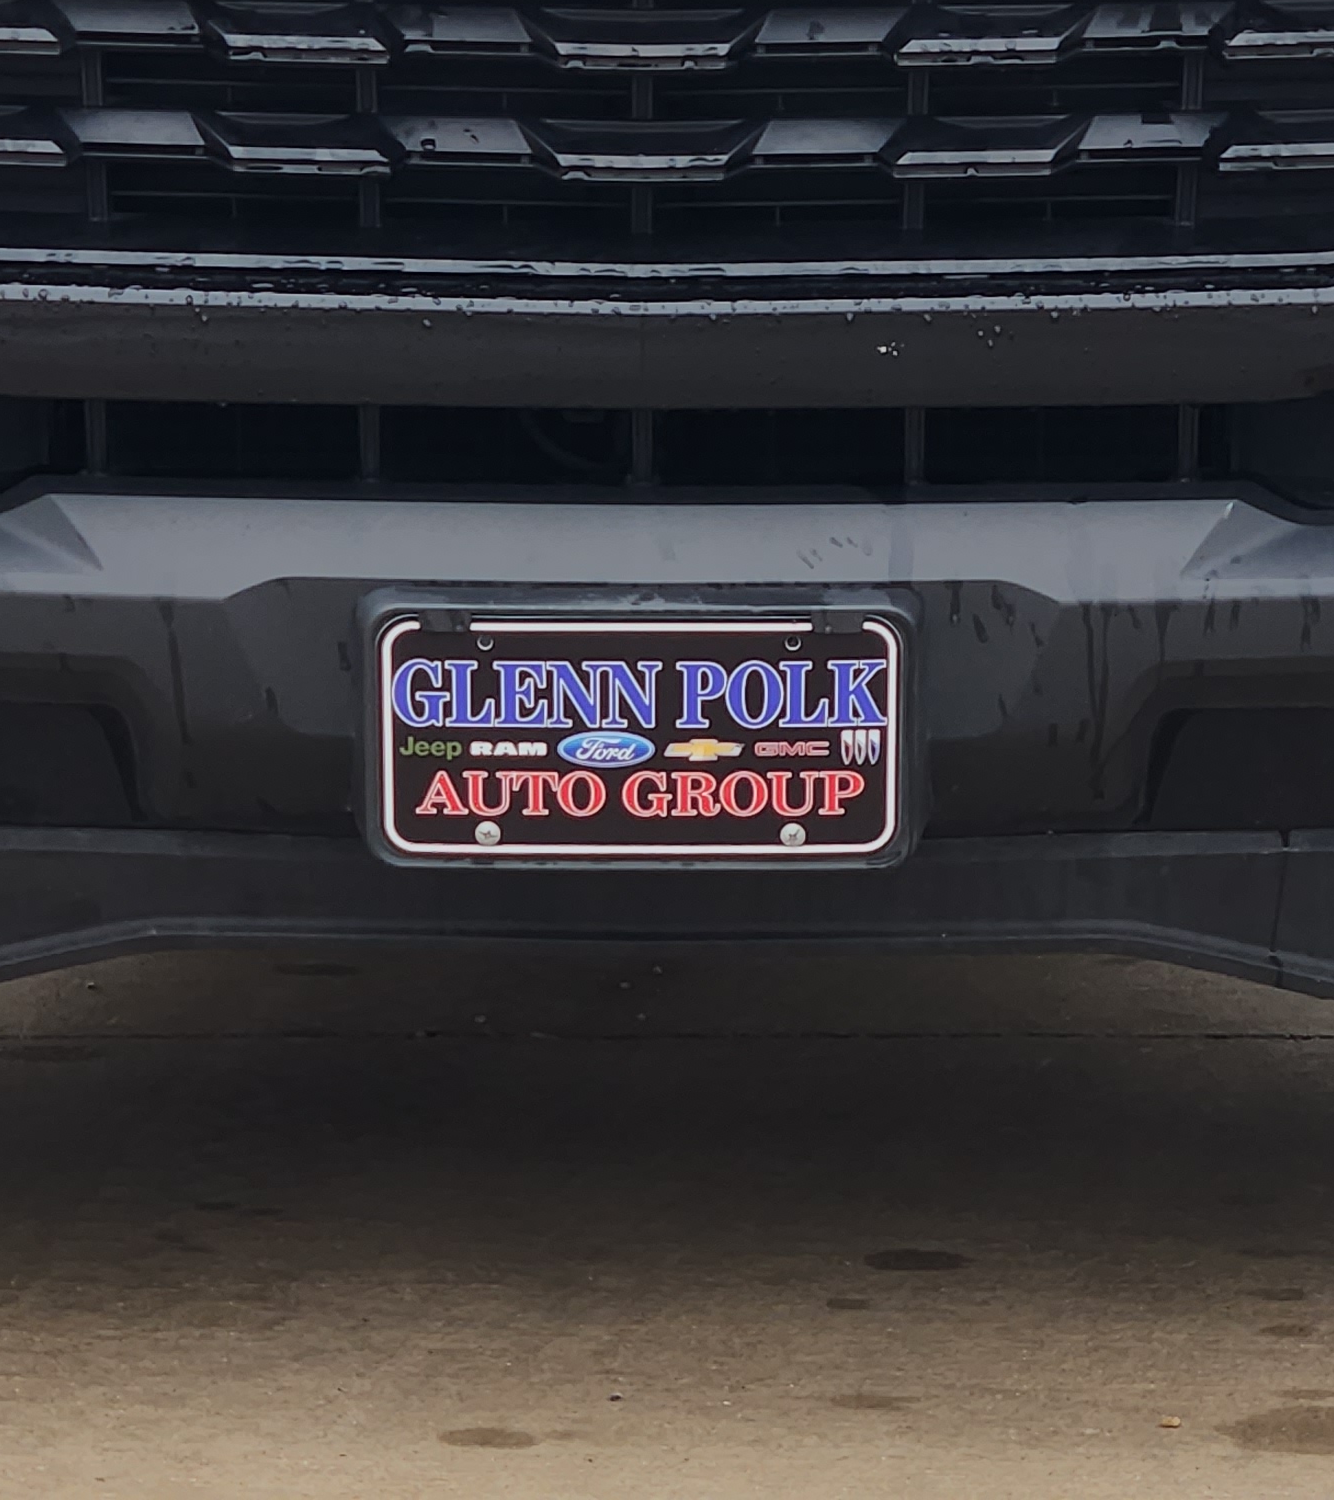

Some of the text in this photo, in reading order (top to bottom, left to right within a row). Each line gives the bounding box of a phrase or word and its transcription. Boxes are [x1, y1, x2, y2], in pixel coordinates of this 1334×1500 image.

[392, 658, 888, 730] GLENN POLK
[400, 736, 830, 762] Jeep RAM Ford GMC
[416, 769, 865, 817] AUTO GROUP
